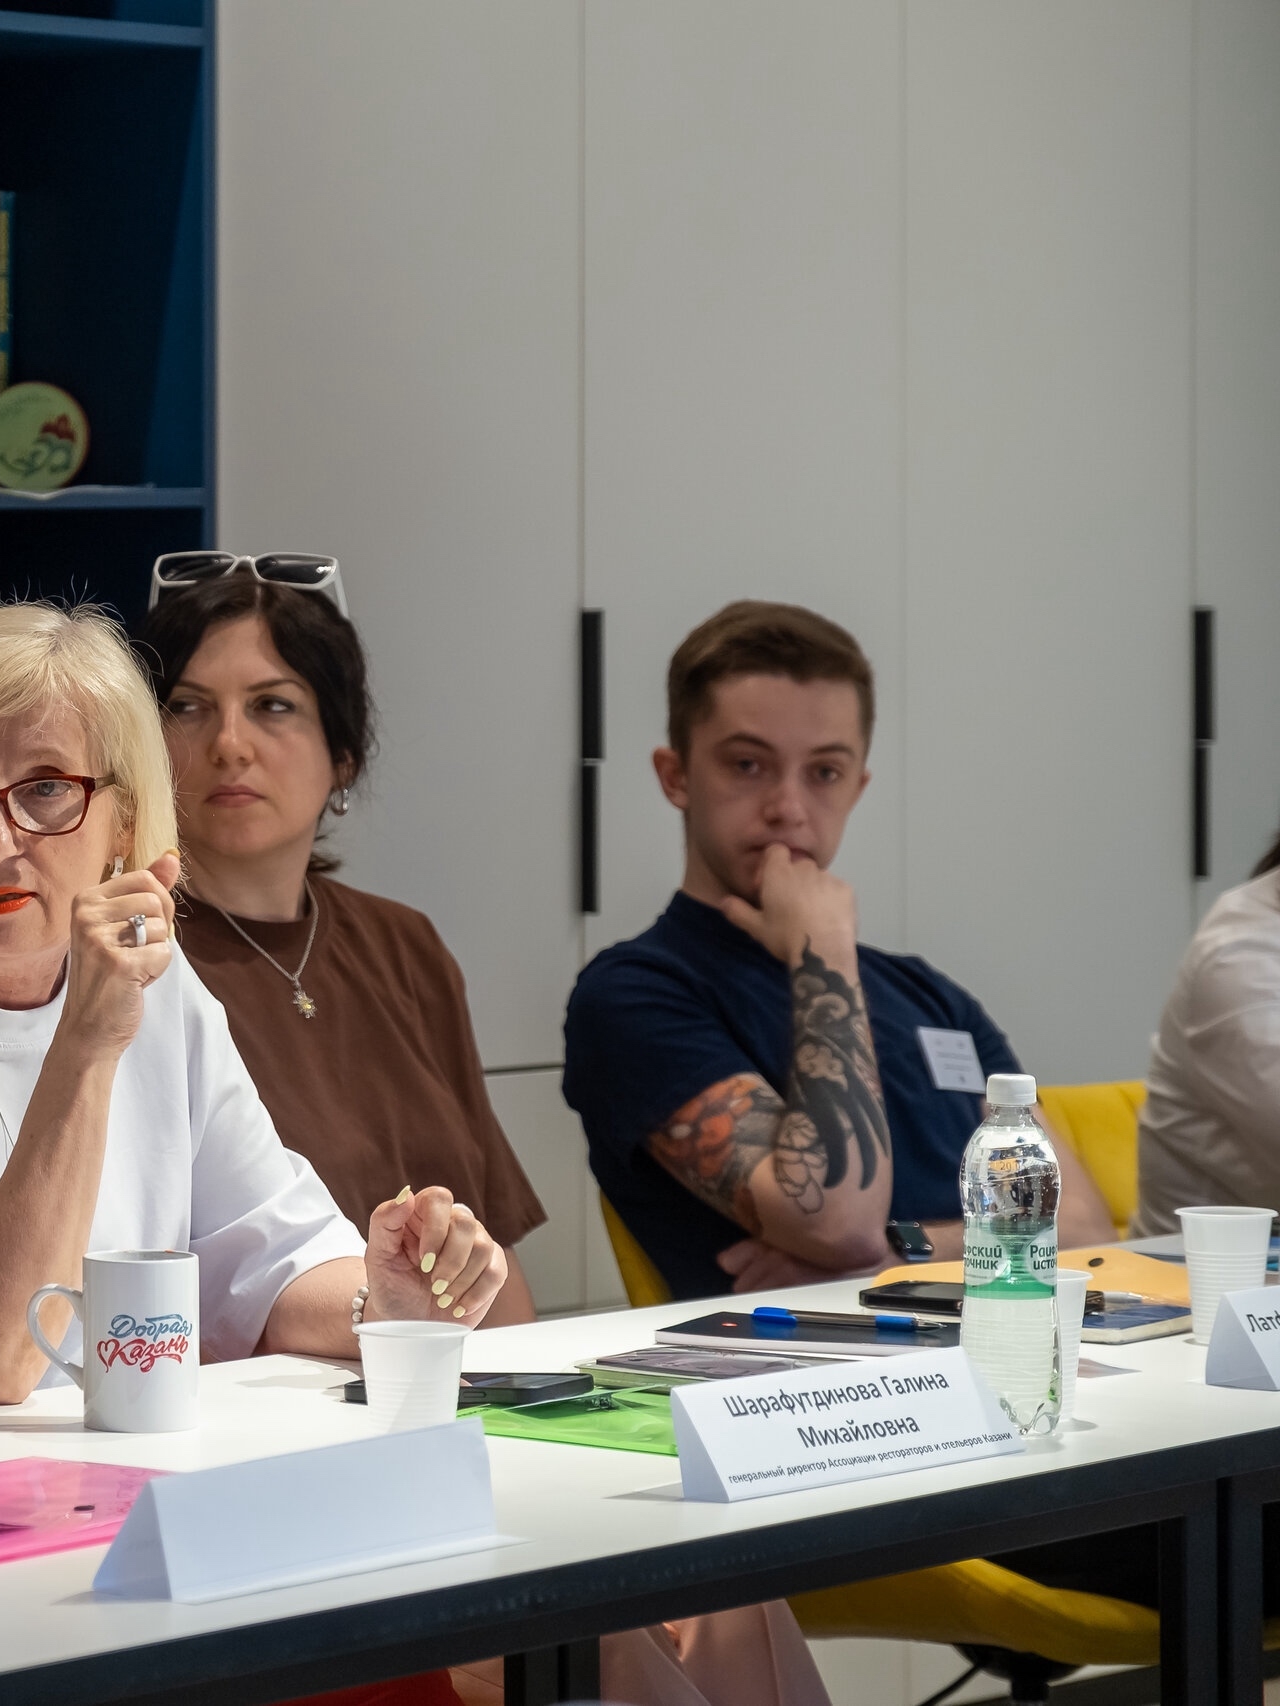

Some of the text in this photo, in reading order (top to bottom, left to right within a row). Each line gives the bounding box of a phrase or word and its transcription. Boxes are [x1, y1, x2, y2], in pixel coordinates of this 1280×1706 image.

[1033, 1259, 1057, 1270] исто
[108, 1314, 192, 1342] Добрая
[97, 1335, 189, 1373] Казань
[723, 1373, 949, 1418] Шарафутдинова Галина
[797, 1416, 920, 1448] Михайловна
[728, 1432, 1013, 1484] генеральный директор Ассоциации рестораторов и отельеров Казани
